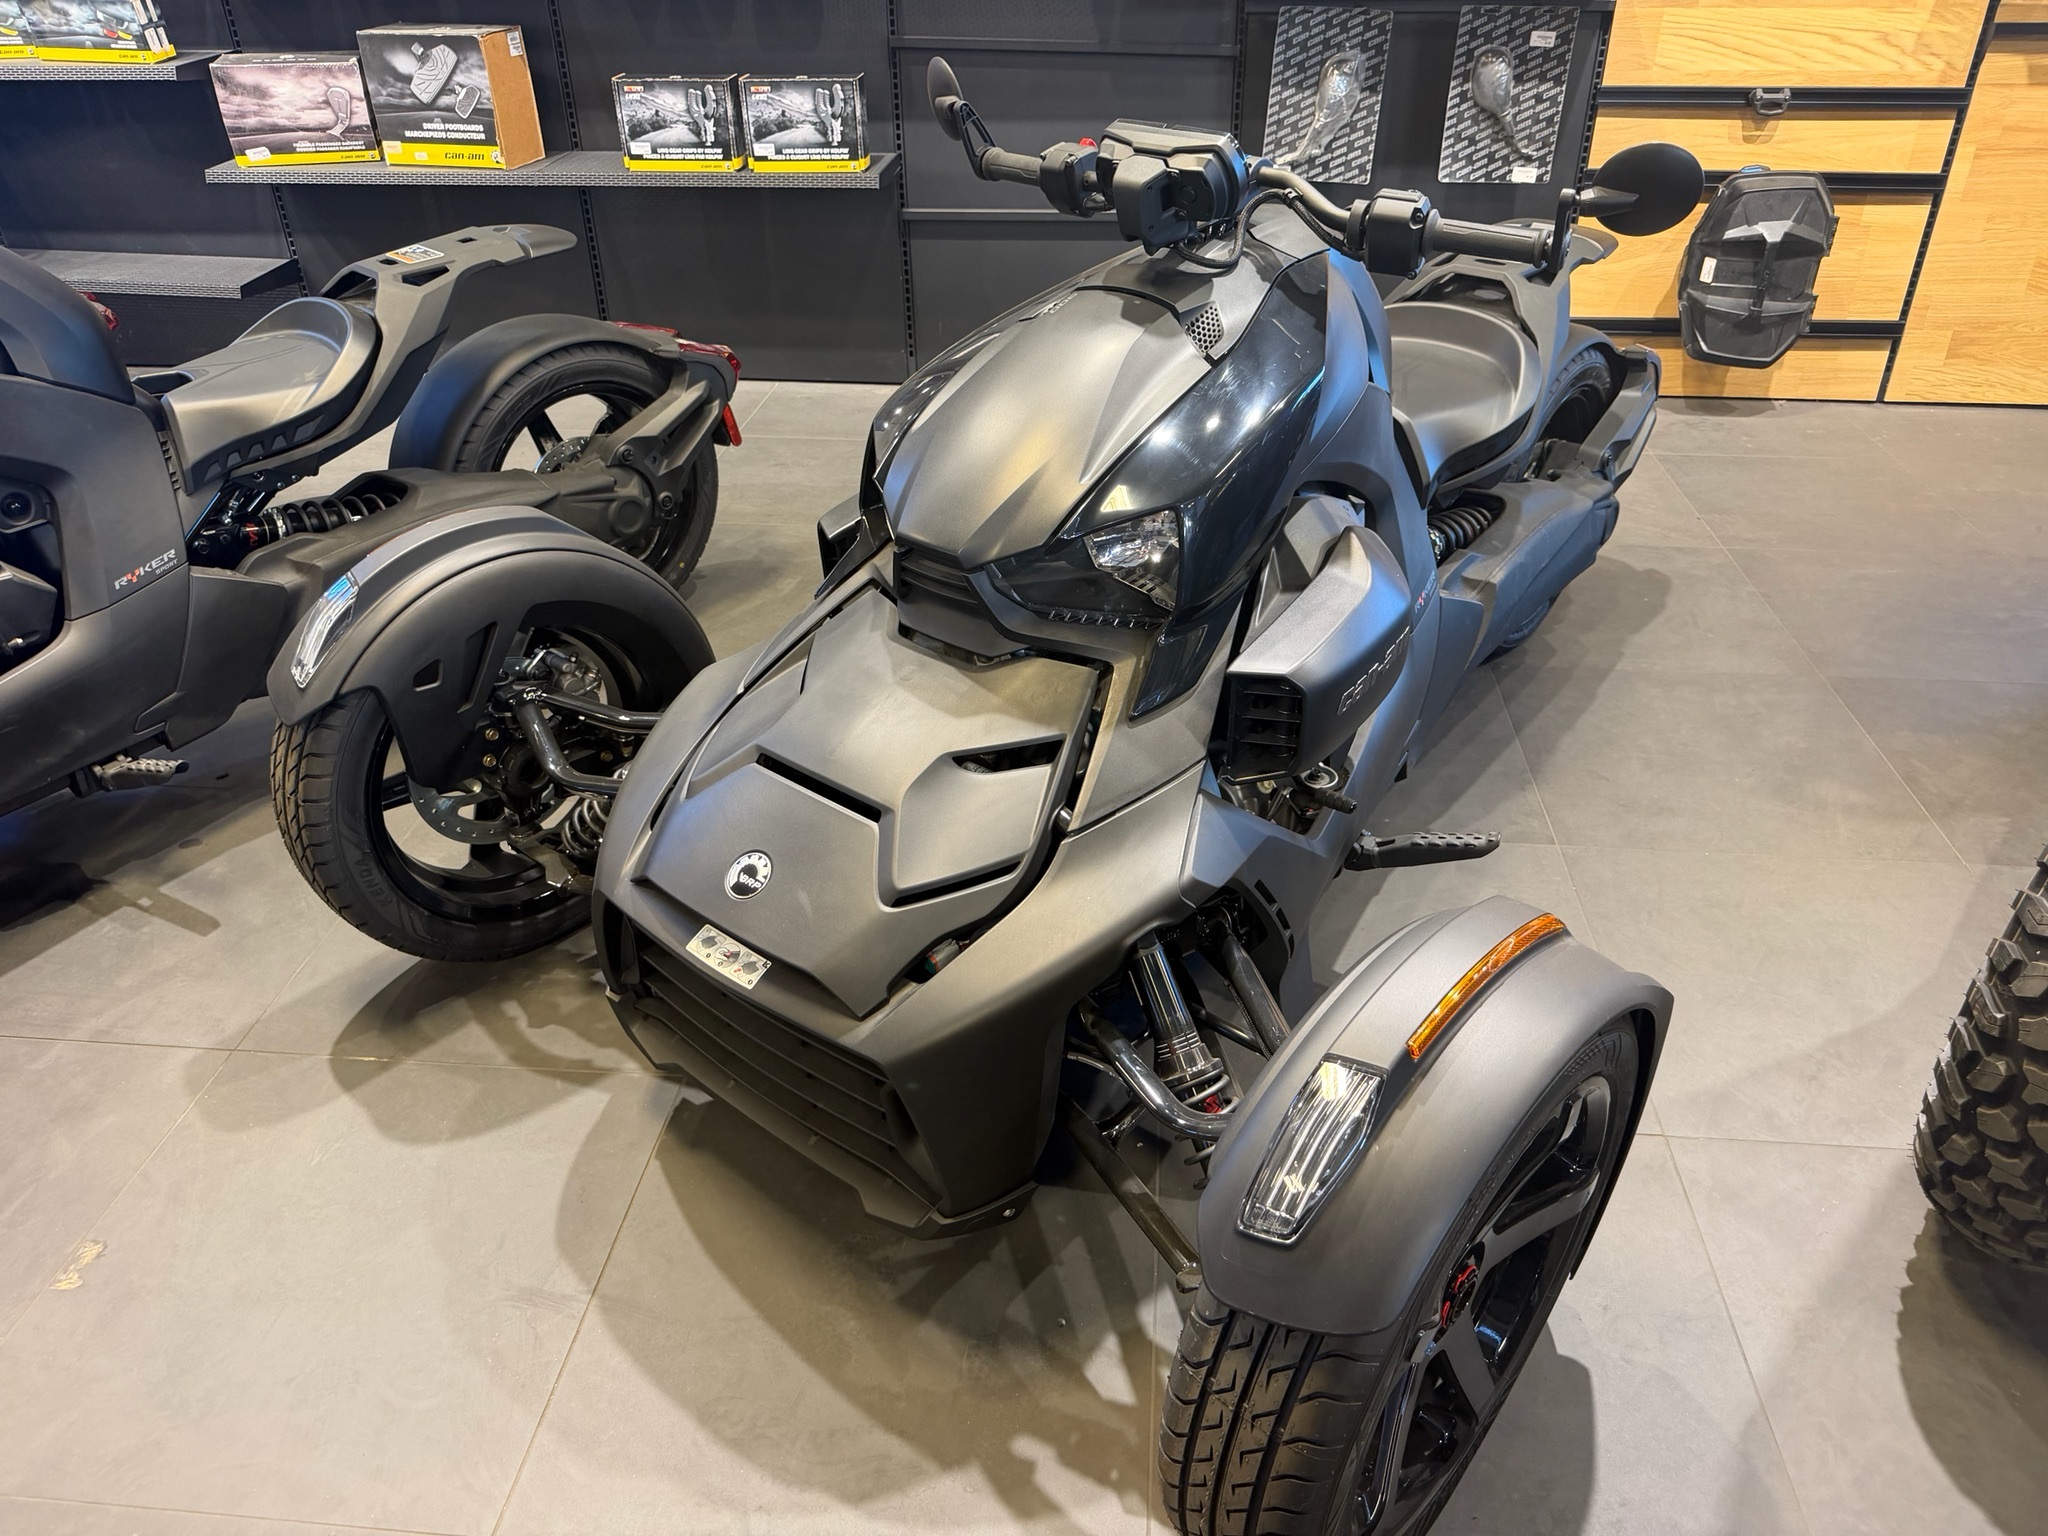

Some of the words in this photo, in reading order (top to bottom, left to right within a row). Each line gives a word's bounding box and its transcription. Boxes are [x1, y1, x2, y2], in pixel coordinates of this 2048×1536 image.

[1293, 24, 1325, 44] can-am
[1477, 14, 1511, 35] can-am
[1492, 17, 1526, 37] can-am
[1516, 15, 1550, 35] can-am
[1308, 27, 1340, 46] can-am
[1331, 26, 1363, 45] can-am
[1291, 45, 1322, 65] can-am
[1305, 48, 1337, 67] can-am
[1288, 65, 1320, 85] can-am
[1523, 60, 1557, 80] can-am
[1520, 81, 1554, 100] can-am
[1516, 101, 1550, 121] can-am
[447, 132, 486, 140] CONDUCTEUR
[1332, 130, 1364, 148] can-am
[444, 152, 484, 160] can-am
[1315, 146, 1347, 165] can-am
[1329, 149, 1361, 167] can-am
[1458, 139, 1491, 158] can-am
[1456, 159, 1487, 178] can-am
[1470, 161, 1502, 180] can-am
[114, 548, 177, 590] RYKER
[155, 558, 178, 575] SPORT
[738, 871, 762, 889] BRP
